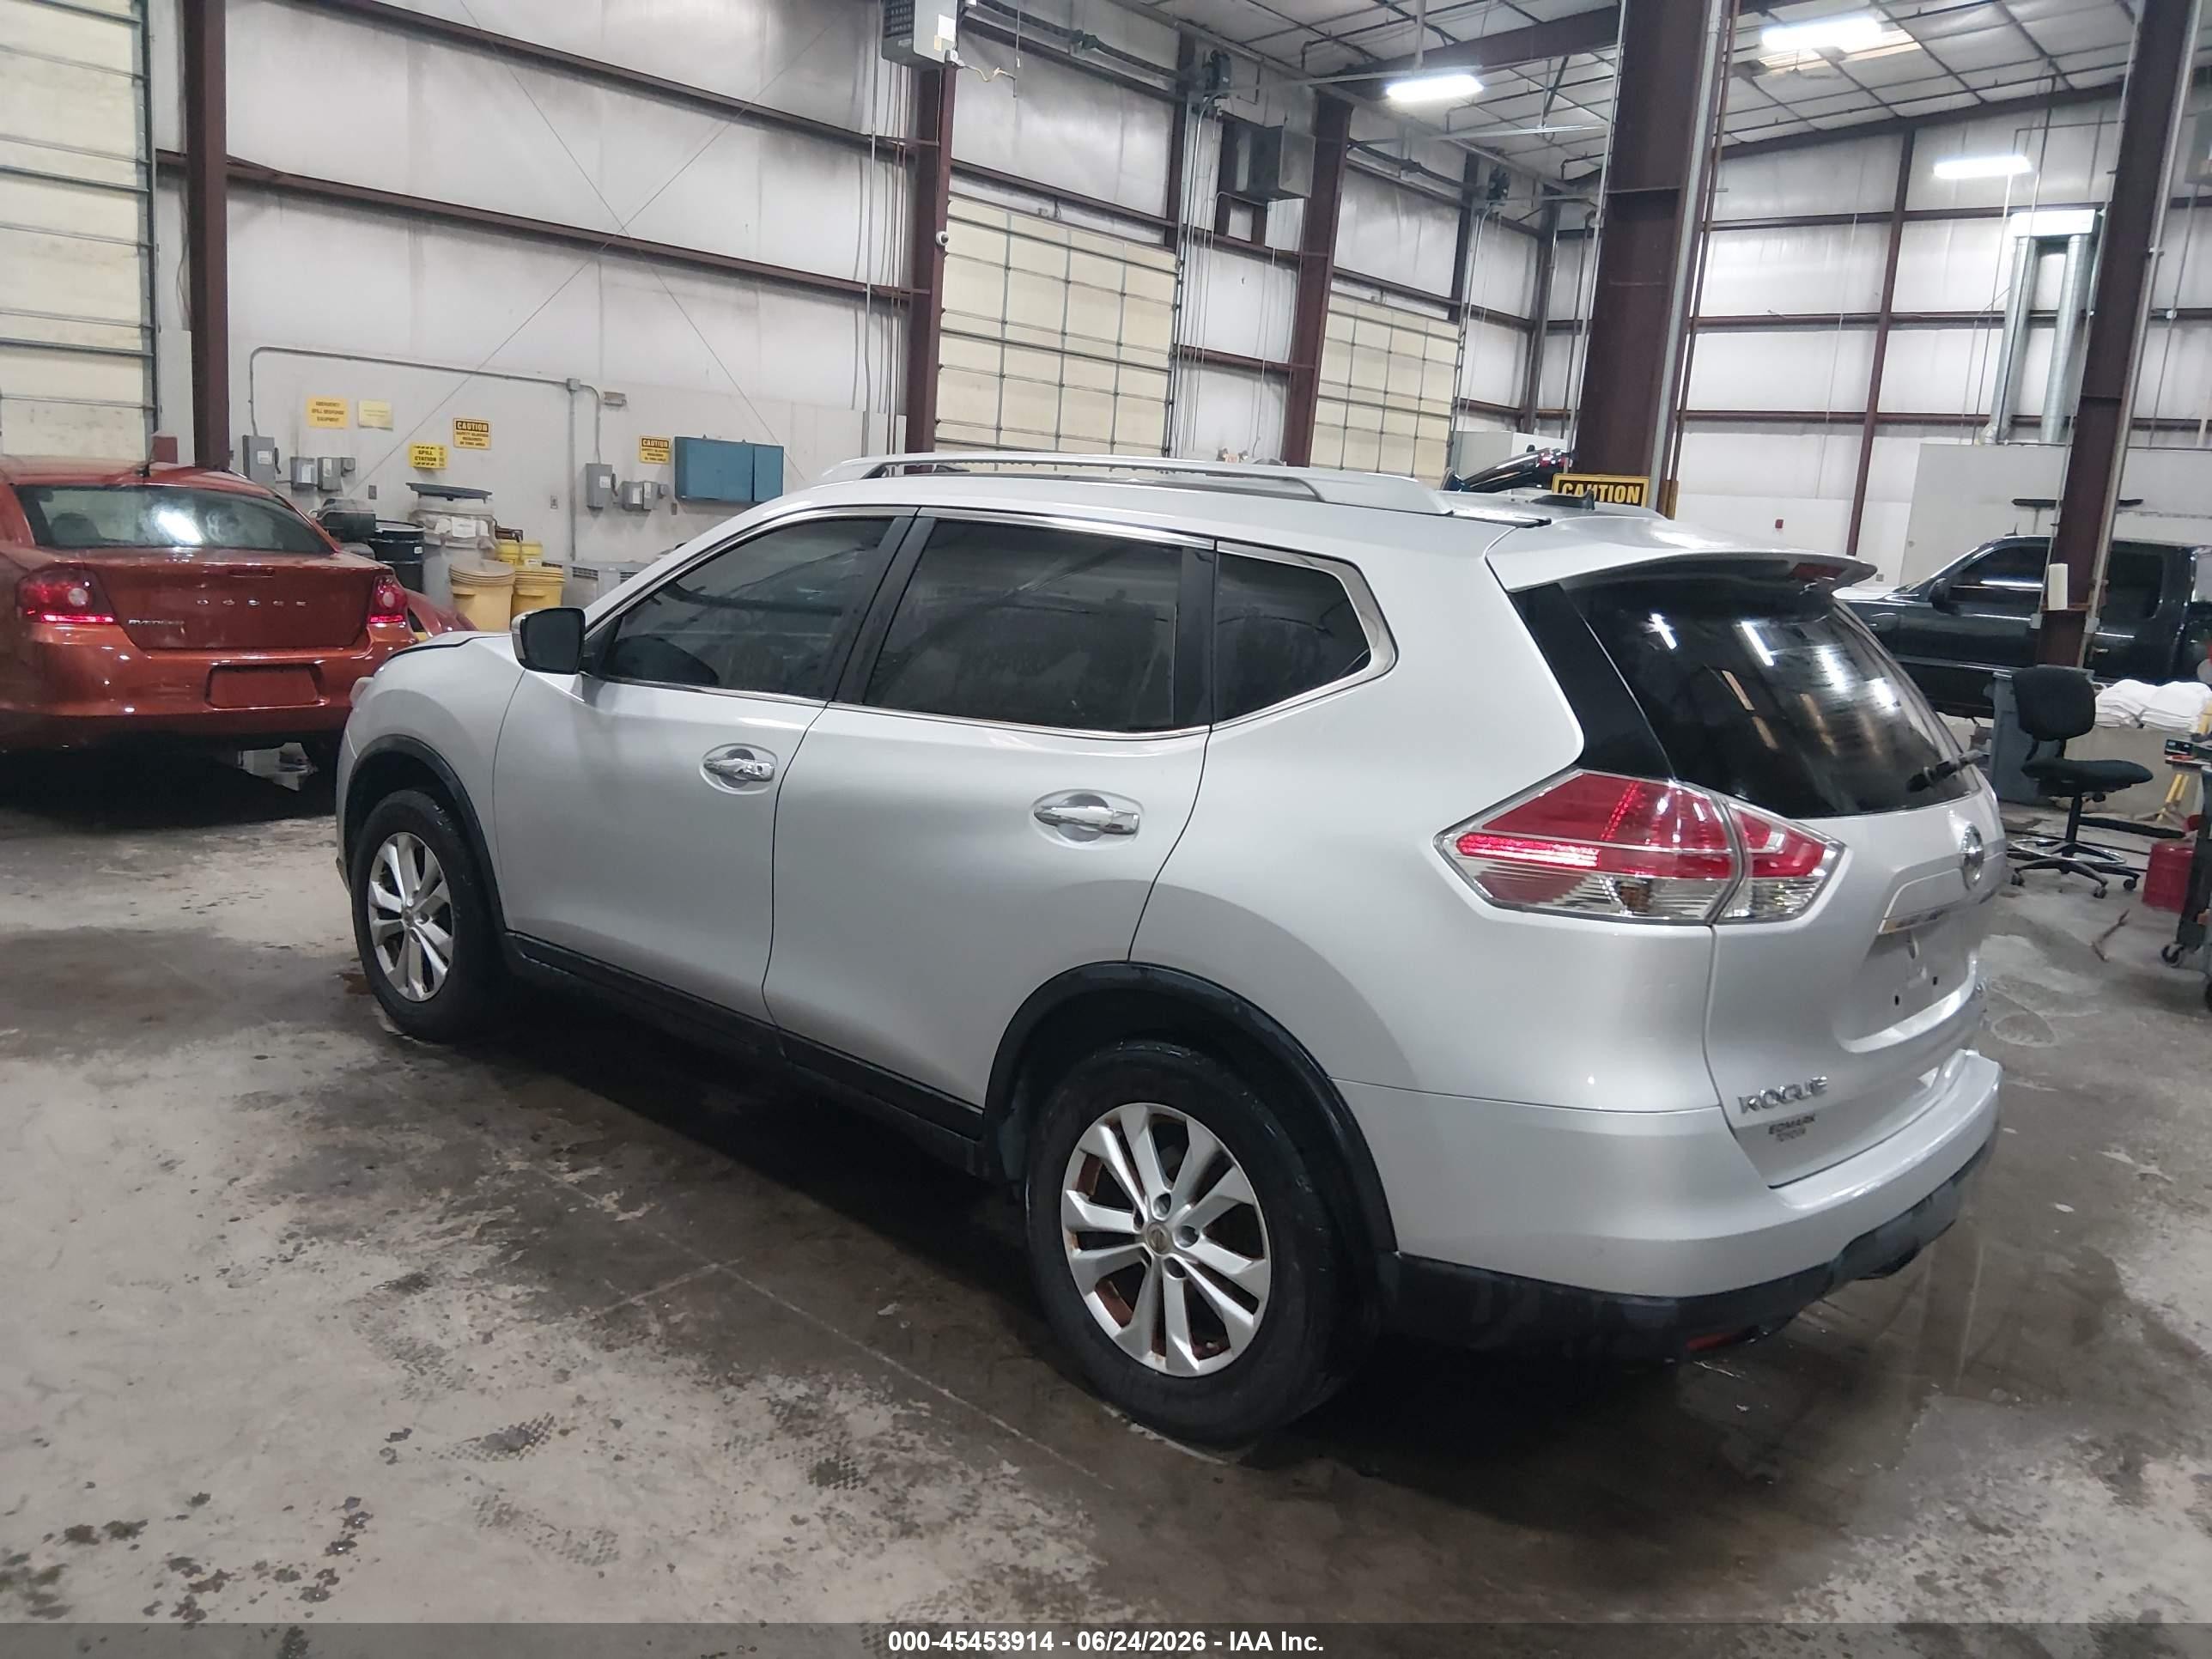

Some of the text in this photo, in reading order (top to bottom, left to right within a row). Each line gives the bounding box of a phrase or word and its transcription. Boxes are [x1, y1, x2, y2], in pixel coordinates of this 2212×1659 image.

[457, 422, 488, 432] CAUTION
[642, 439, 668, 448] CAUTION
[1737, 1076, 1828, 1115] ROGUE
